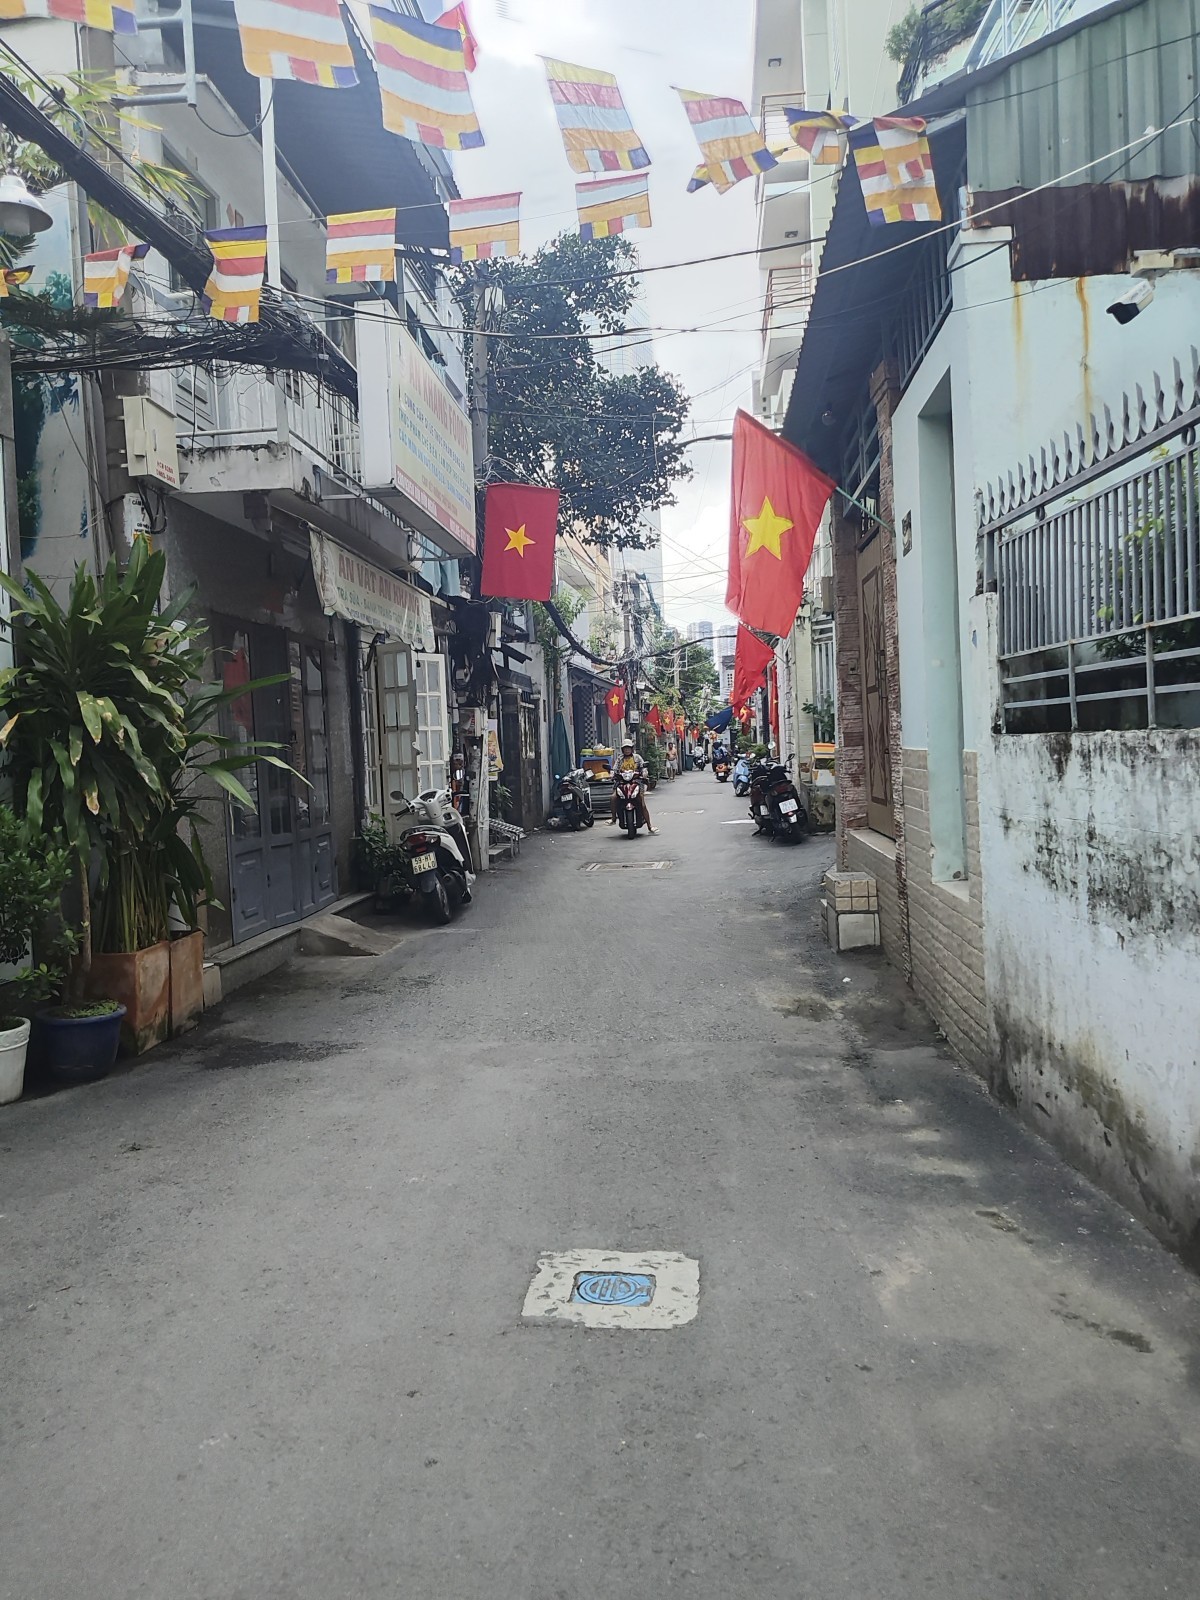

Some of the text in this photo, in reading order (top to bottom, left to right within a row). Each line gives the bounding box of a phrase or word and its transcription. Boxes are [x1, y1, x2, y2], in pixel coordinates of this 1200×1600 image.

[423, 367, 447, 429] KHANG
[449, 402, 468, 456] FOODS
[379, 575, 392, 602] AN
